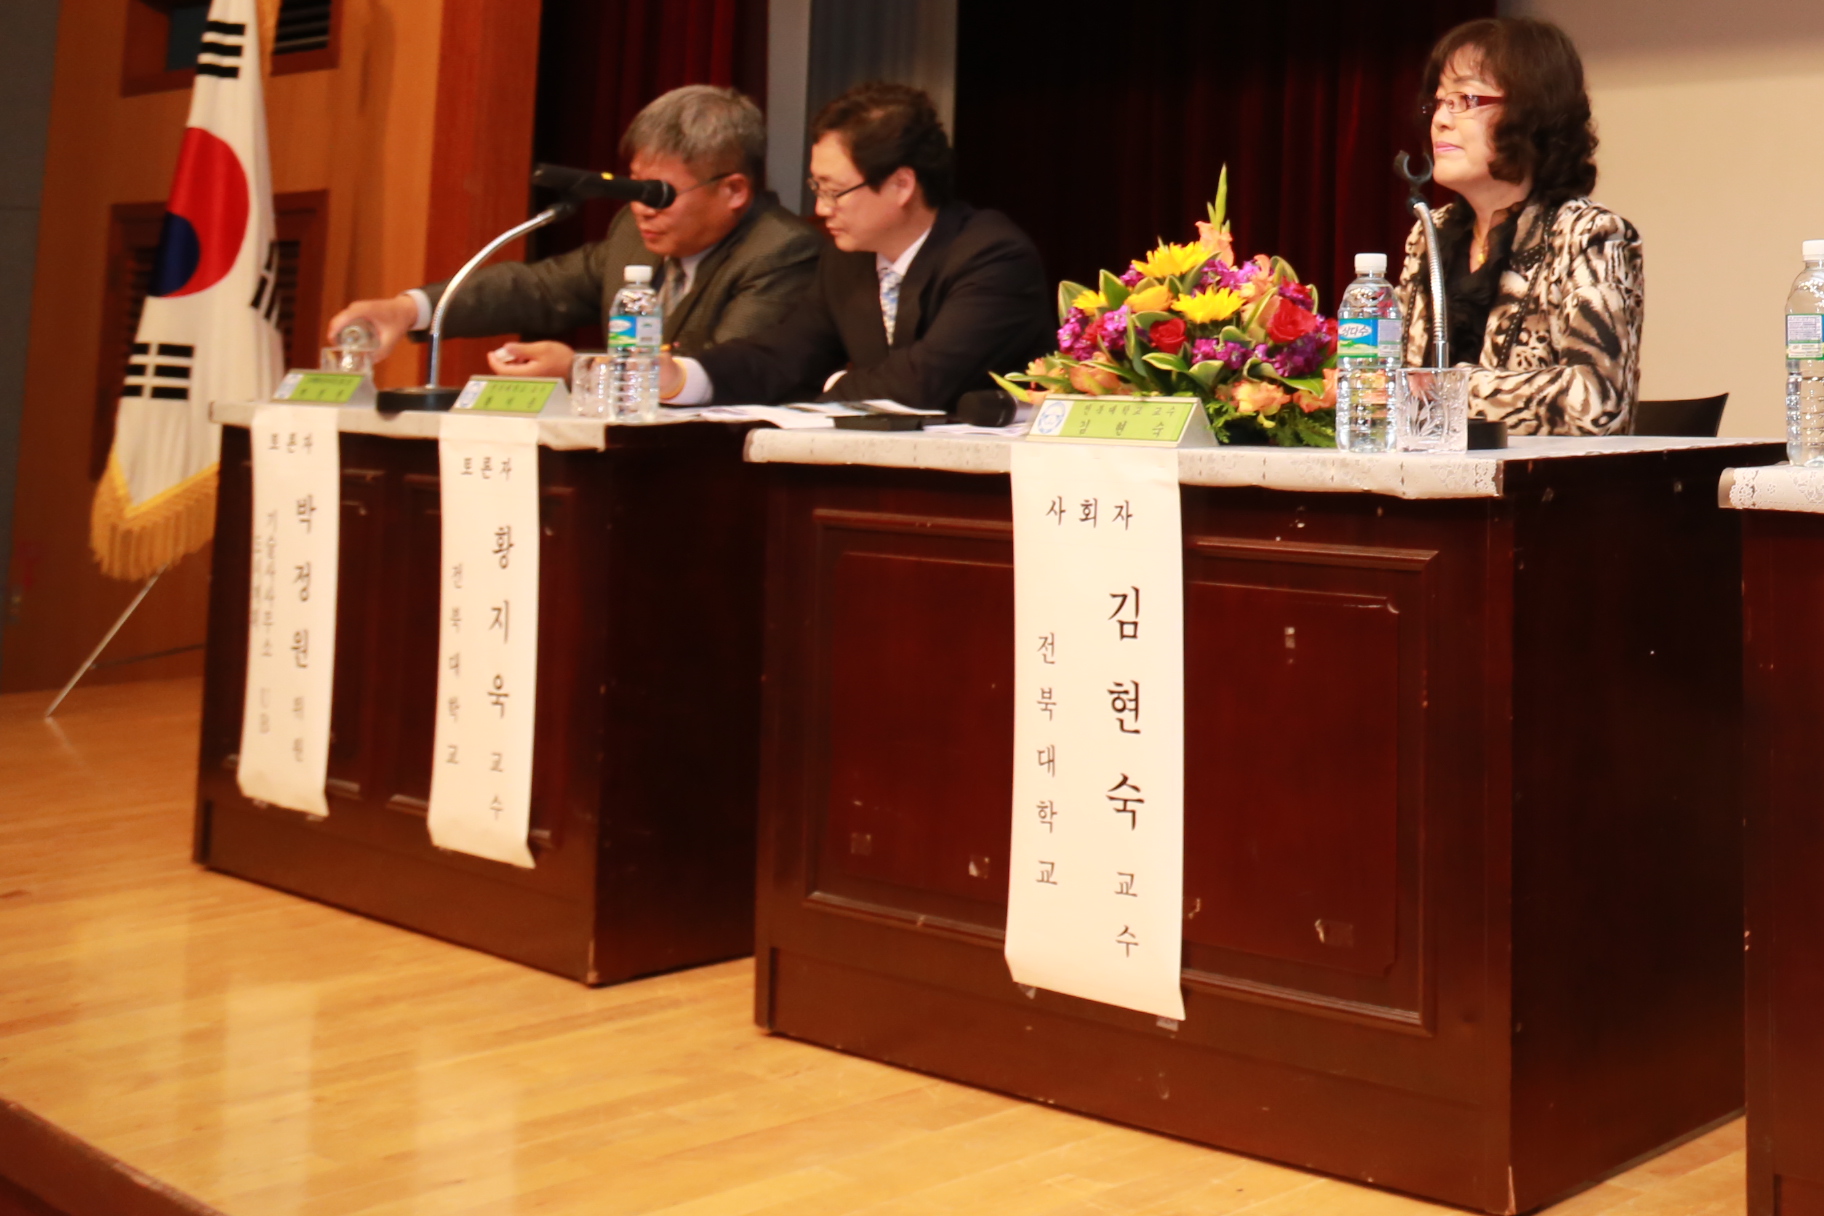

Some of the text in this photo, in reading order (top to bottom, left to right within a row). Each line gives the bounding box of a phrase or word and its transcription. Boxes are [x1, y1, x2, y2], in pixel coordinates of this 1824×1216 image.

[460, 456, 513, 481] 토론자
[1047, 496, 1132, 529] 사회자
[487, 525, 516, 822] 황지욱 교수
[1037, 633, 1057, 885] 전북대학교
[1107, 586, 1144, 956] 김현숙 교수
